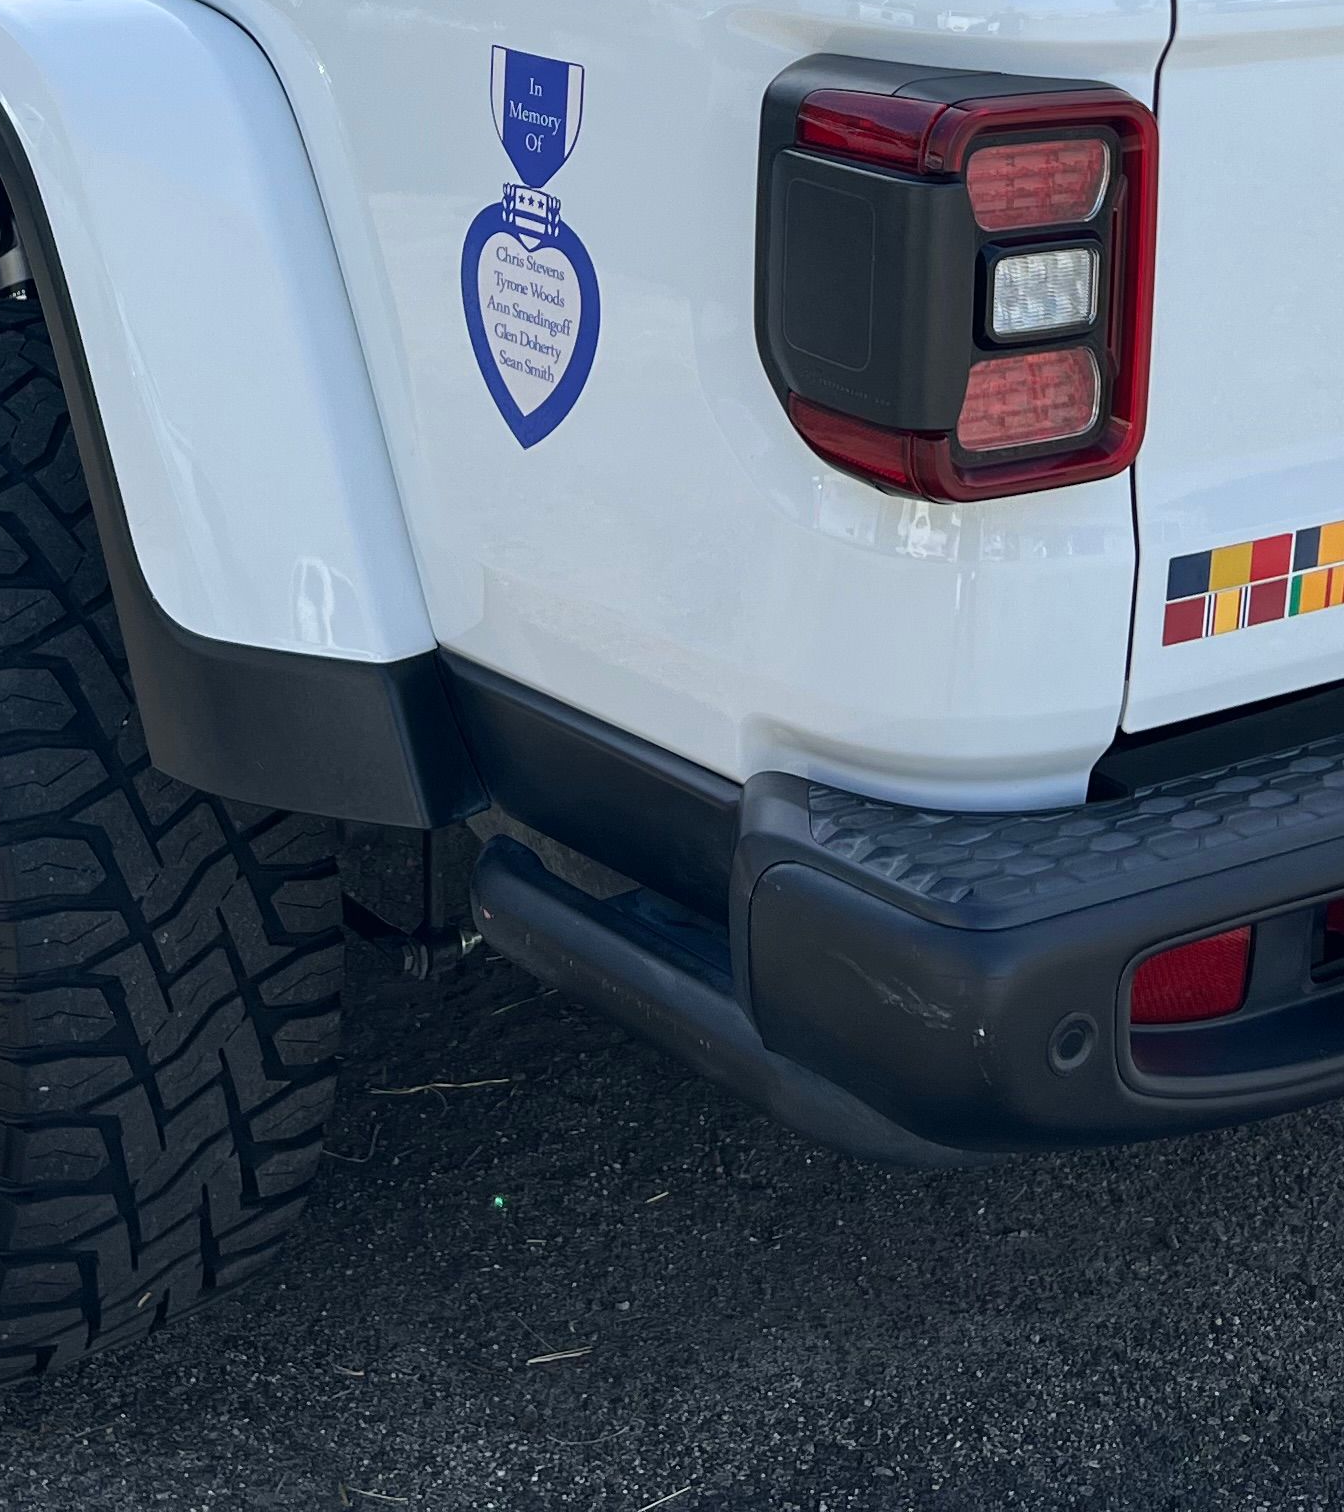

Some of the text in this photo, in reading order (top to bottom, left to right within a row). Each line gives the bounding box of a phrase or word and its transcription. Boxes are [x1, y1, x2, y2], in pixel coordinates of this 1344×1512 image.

[529, 78, 543, 97] In
[509, 100, 562, 136] Memory
[525, 133, 545, 153] Of
[496, 246, 565, 281] Chris Stevens
[494, 270, 565, 308] Tyrone Woods
[487, 294, 573, 338] Ann Smedingoff
[494, 322, 562, 364] Glen Doherty
[499, 349, 555, 383] Sean Smith
